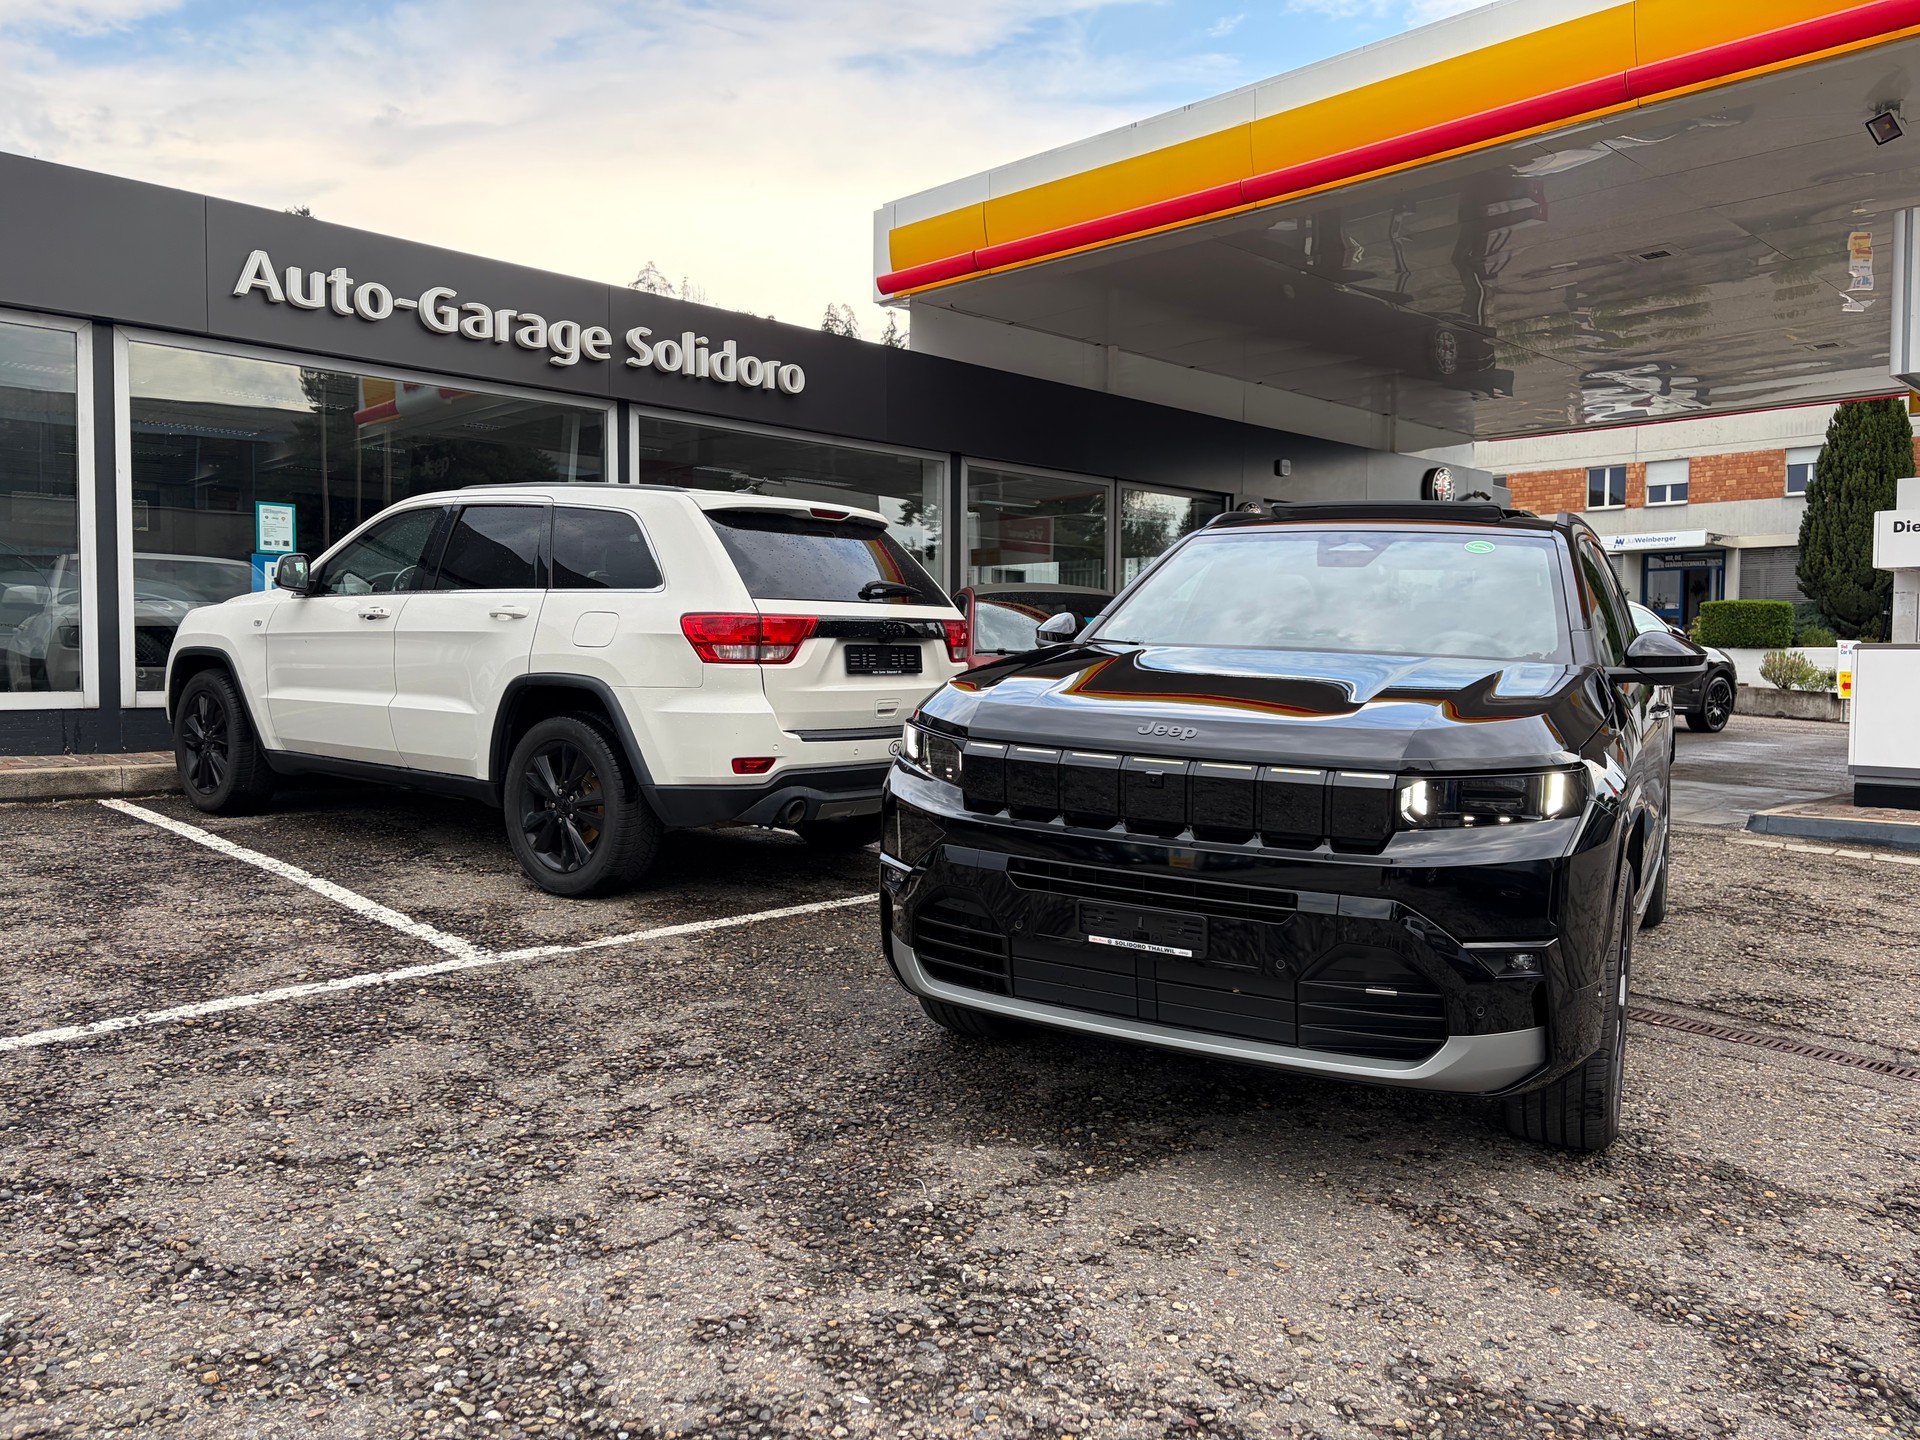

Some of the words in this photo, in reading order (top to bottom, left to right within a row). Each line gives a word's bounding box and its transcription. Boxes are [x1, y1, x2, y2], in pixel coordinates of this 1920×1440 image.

[233, 249, 612, 366] Auto-Garage
[626, 326, 805, 394] Solidoro
[1137, 721, 1198, 741] Jeep
[1114, 940, 1147, 950] SOLIDORO
[1148, 945, 1176, 954] THALWIL
